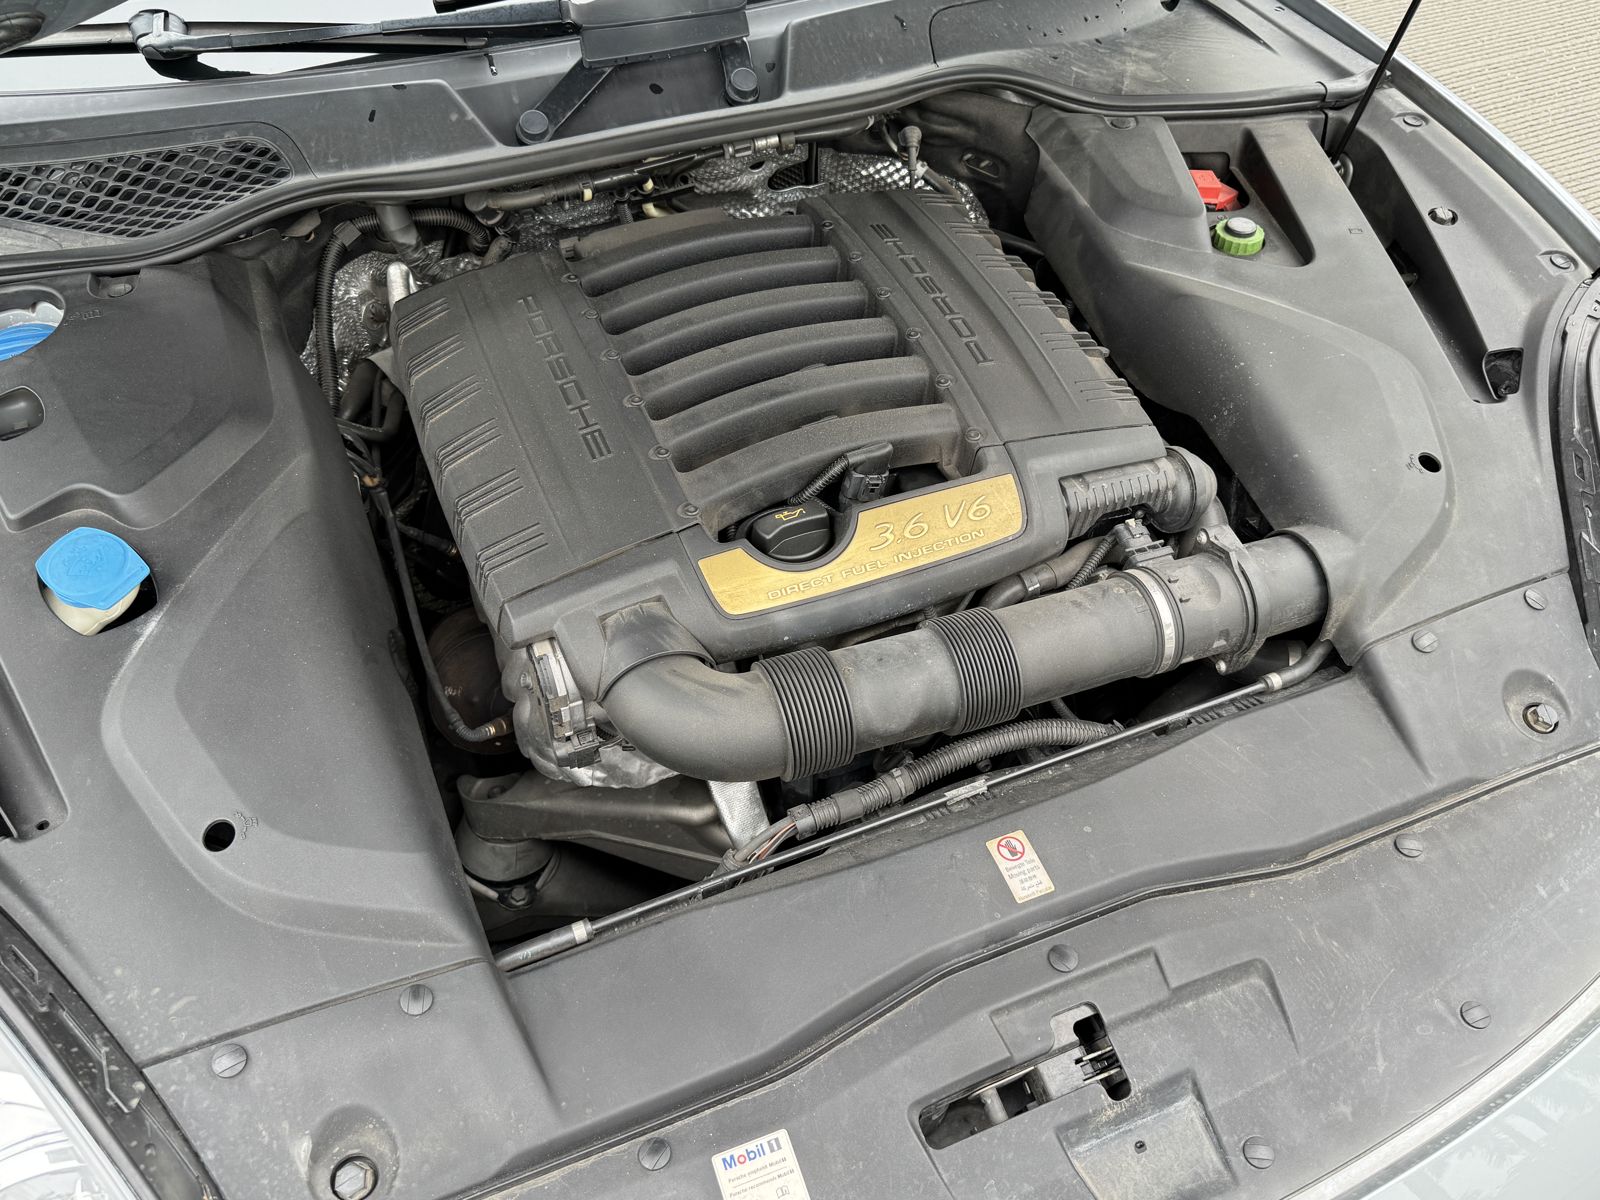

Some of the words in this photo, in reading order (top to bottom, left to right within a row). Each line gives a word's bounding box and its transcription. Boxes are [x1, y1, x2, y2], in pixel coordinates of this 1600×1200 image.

[870, 223, 995, 364] PORSCHE
[518, 296, 612, 462] PORSCHE
[868, 512, 930, 551] 3.6
[943, 495, 992, 528] V6
[767, 574, 834, 601] DIRECT
[842, 559, 888, 580] FUEL
[893, 529, 986, 564] INJECTION
[721, 1143, 766, 1171] Mobil
